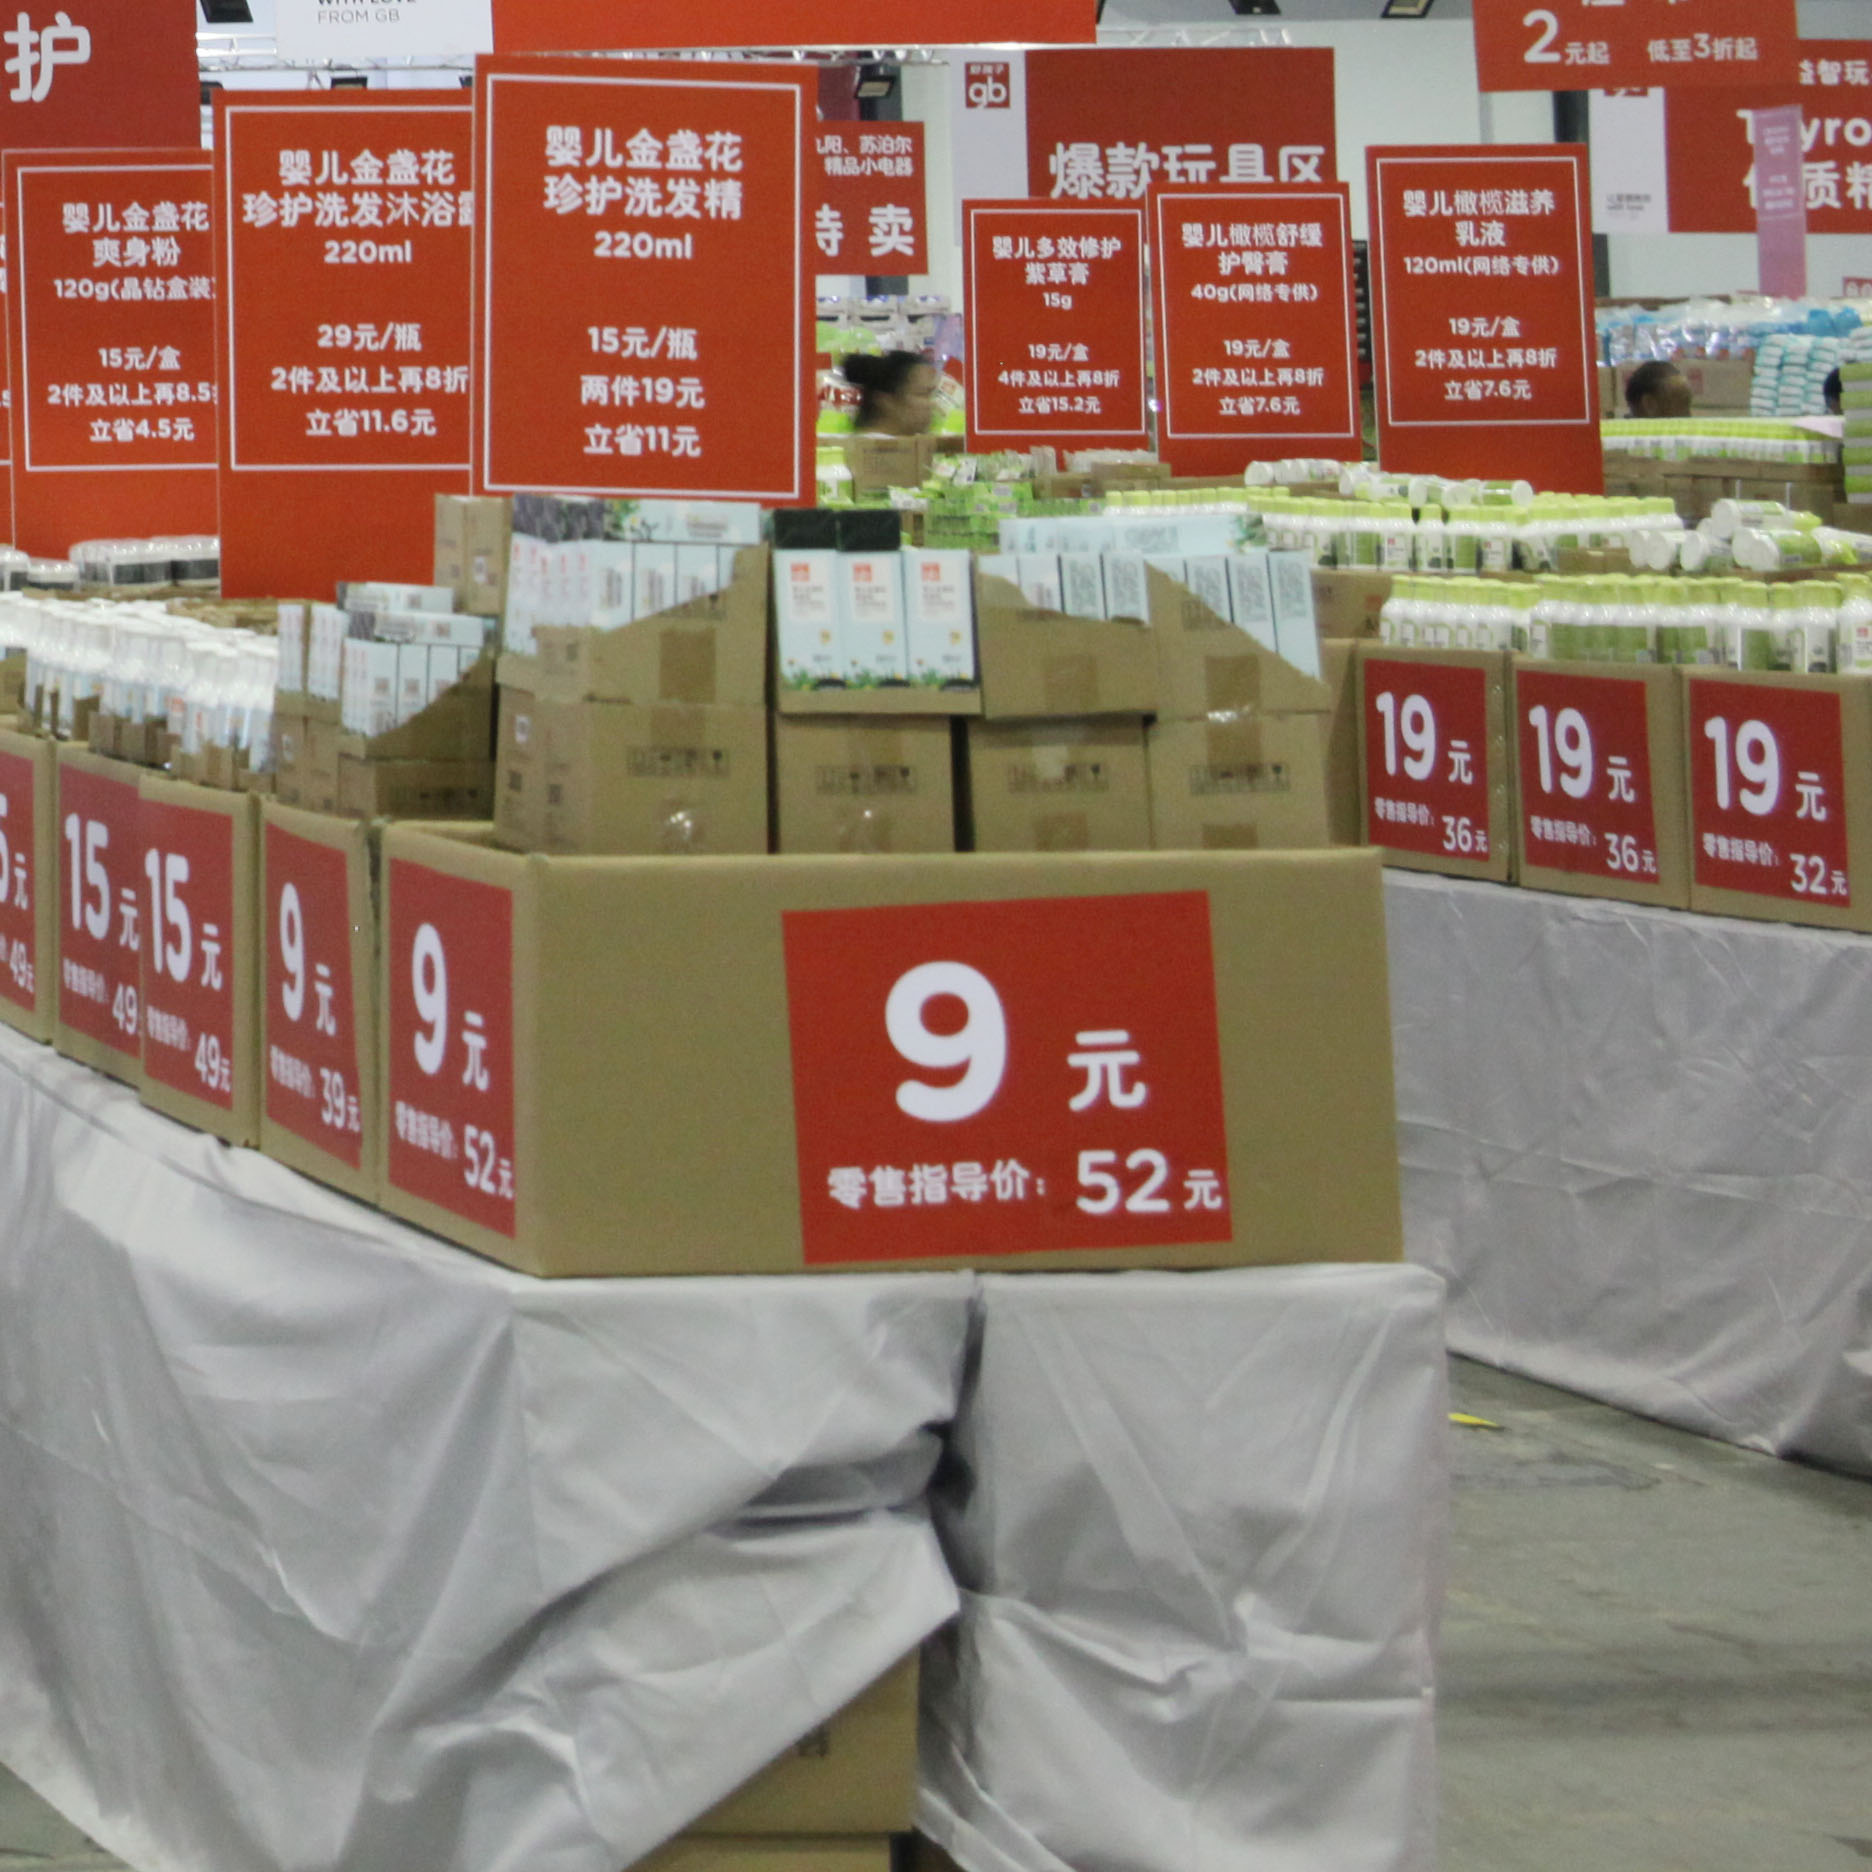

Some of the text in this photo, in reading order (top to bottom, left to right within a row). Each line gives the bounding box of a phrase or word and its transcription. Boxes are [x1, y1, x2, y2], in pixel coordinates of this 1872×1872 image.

[317, 8, 400, 24] FROM GB
[1523, 9, 1757, 64] 2元起 低至3折起
[545, 126, 742, 173] 婴儿金盏花
[279, 149, 454, 185] 婴儿金盏花
[1050, 142, 1326, 199] 爆款玩具区
[544, 174, 742, 219] 珍护洗发精
[1404, 189, 1554, 217] 婴儿橄榄滋养
[63, 201, 209, 233] 婴儿金盏花
[594, 231, 692, 259] 220ml
[1182, 223, 1322, 249] 婴儿橄榄舒缓
[1456, 220, 1505, 246] 乳液
[93, 236, 180, 267] 爽身粉
[325, 240, 411, 263] 220ml
[993, 236, 1121, 260] 婴儿多效修护
[1025, 262, 1089, 284] 紫草膏
[1218, 251, 1288, 275] 护臀膏
[1043, 292, 1072, 310] 15g
[318, 322, 421, 351] 29元/瓶
[1449, 316, 1520, 337] 19元/盒
[588, 326, 697, 360] 15元/瓶
[1029, 343, 1088, 361] 19元/盒
[1224, 339, 1289, 358] 19元/盒
[99, 346, 180, 370] 15元/盒
[1415, 348, 1556, 369] 2件及以上再8折
[270, 366, 469, 396] 2件及以上再8折
[998, 370, 1119, 387] 4件及以上再8折
[1192, 368, 1323, 386] 2件及以上再8折
[1445, 380, 1532, 400] 立省7.6元
[581, 375, 705, 408] 两件19元
[1019, 396, 1101, 414] 立省15.2元
[1220, 396, 1300, 415] 立省7.6元
[90, 418, 194, 442] 立省4.5元
[306, 408, 436, 436] 立省11.6元
[584, 424, 701, 457] 立省11元
[1376, 692, 1472, 784] 19元
[1529, 706, 1634, 802] 19元
[1705, 717, 1826, 821] 19元
[886, 962, 1146, 1121] 9元
